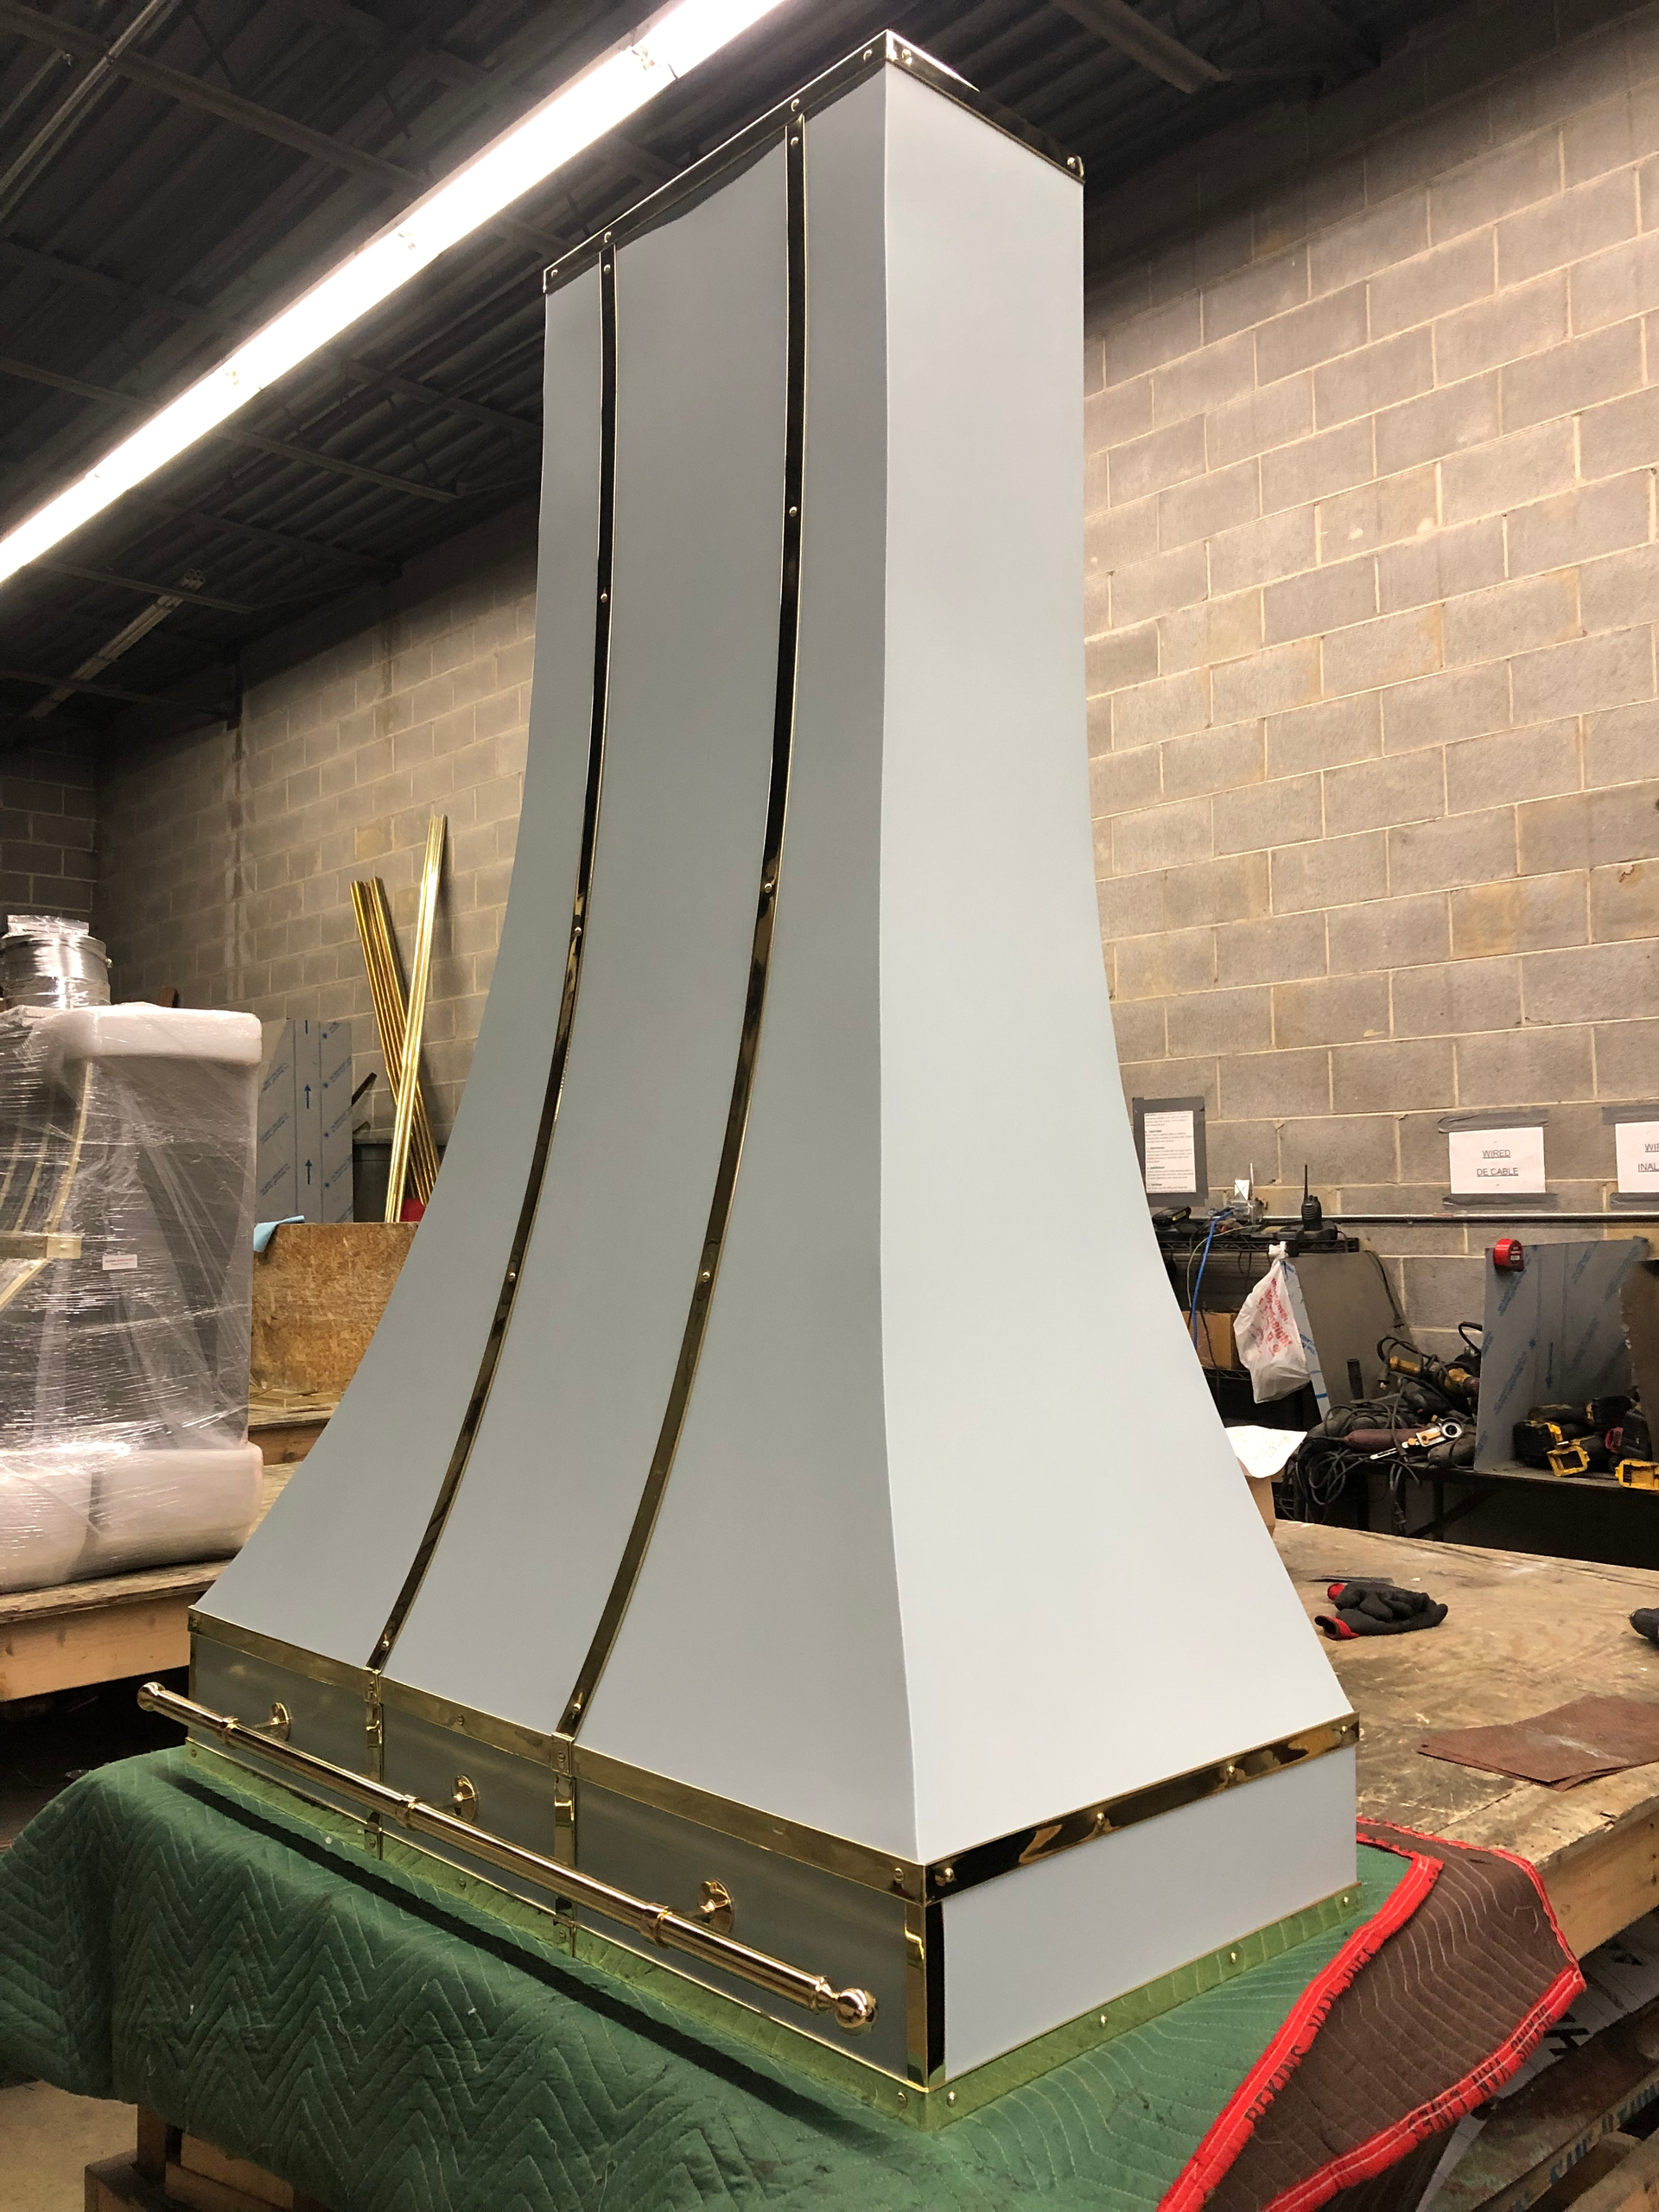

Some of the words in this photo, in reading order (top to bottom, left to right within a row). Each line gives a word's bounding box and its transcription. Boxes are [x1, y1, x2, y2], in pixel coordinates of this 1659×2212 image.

[1482, 1149, 1511, 1159] WIRED
[1477, 1168, 1488, 1177] DE
[1491, 1167, 1519, 1177] CABLE
